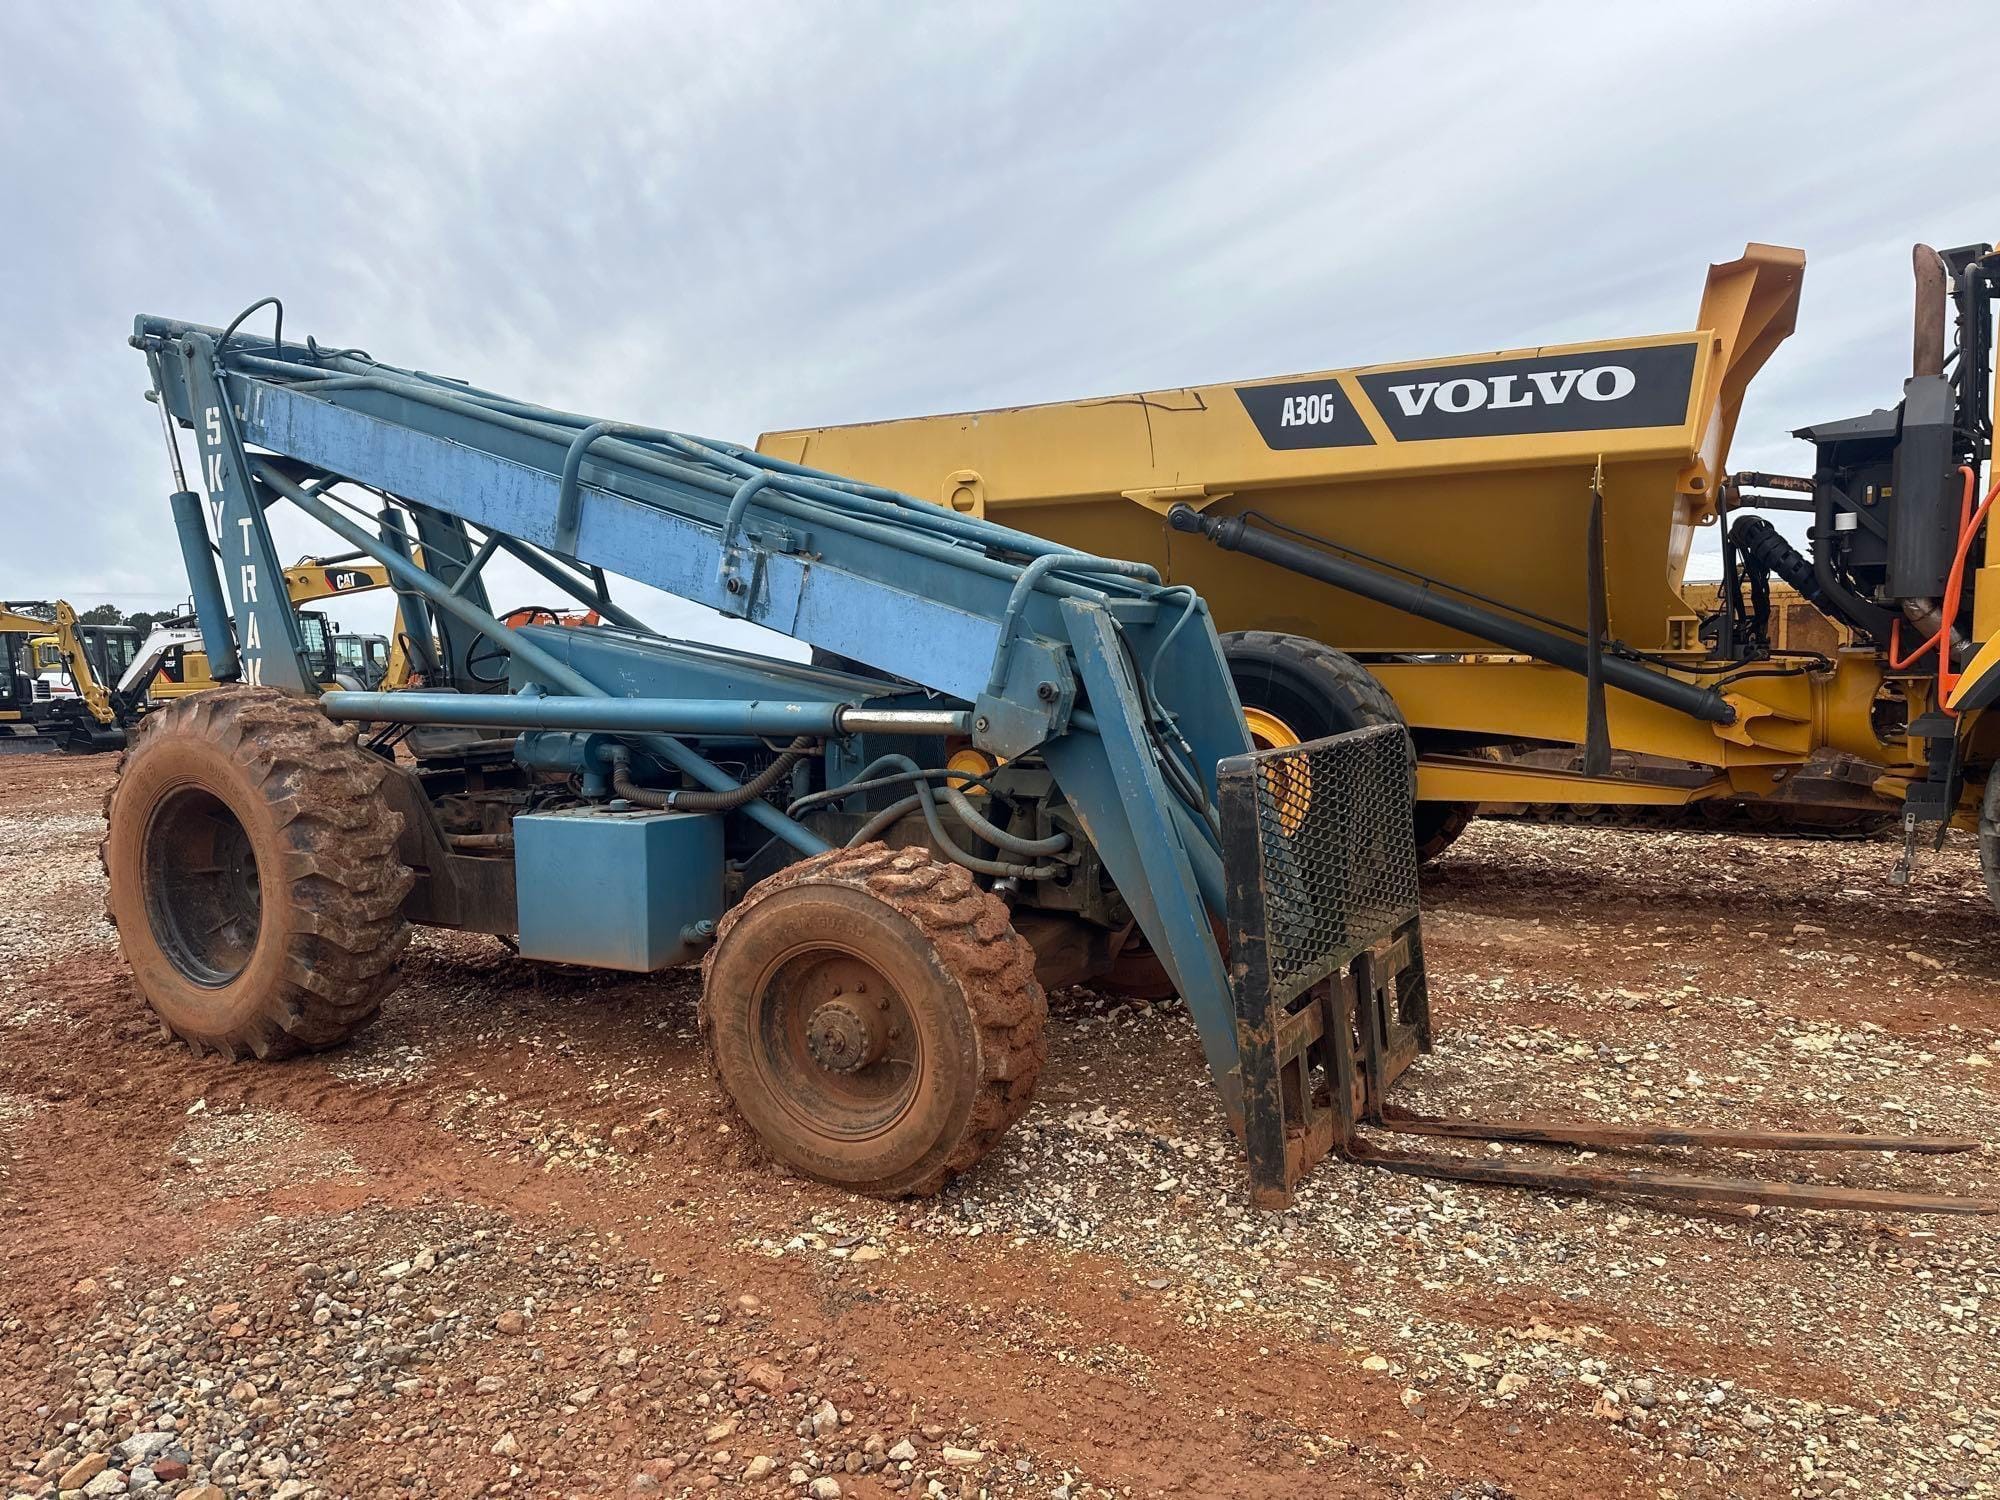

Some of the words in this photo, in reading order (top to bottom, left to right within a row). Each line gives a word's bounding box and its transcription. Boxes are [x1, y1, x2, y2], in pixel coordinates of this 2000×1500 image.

[1281, 393, 1334, 427] A30G
[1389, 365, 1636, 417] VOLVO
[204, 405, 225, 539] SKY
[238, 517, 262, 686] TRAK
[336, 572, 356, 590] CAT
